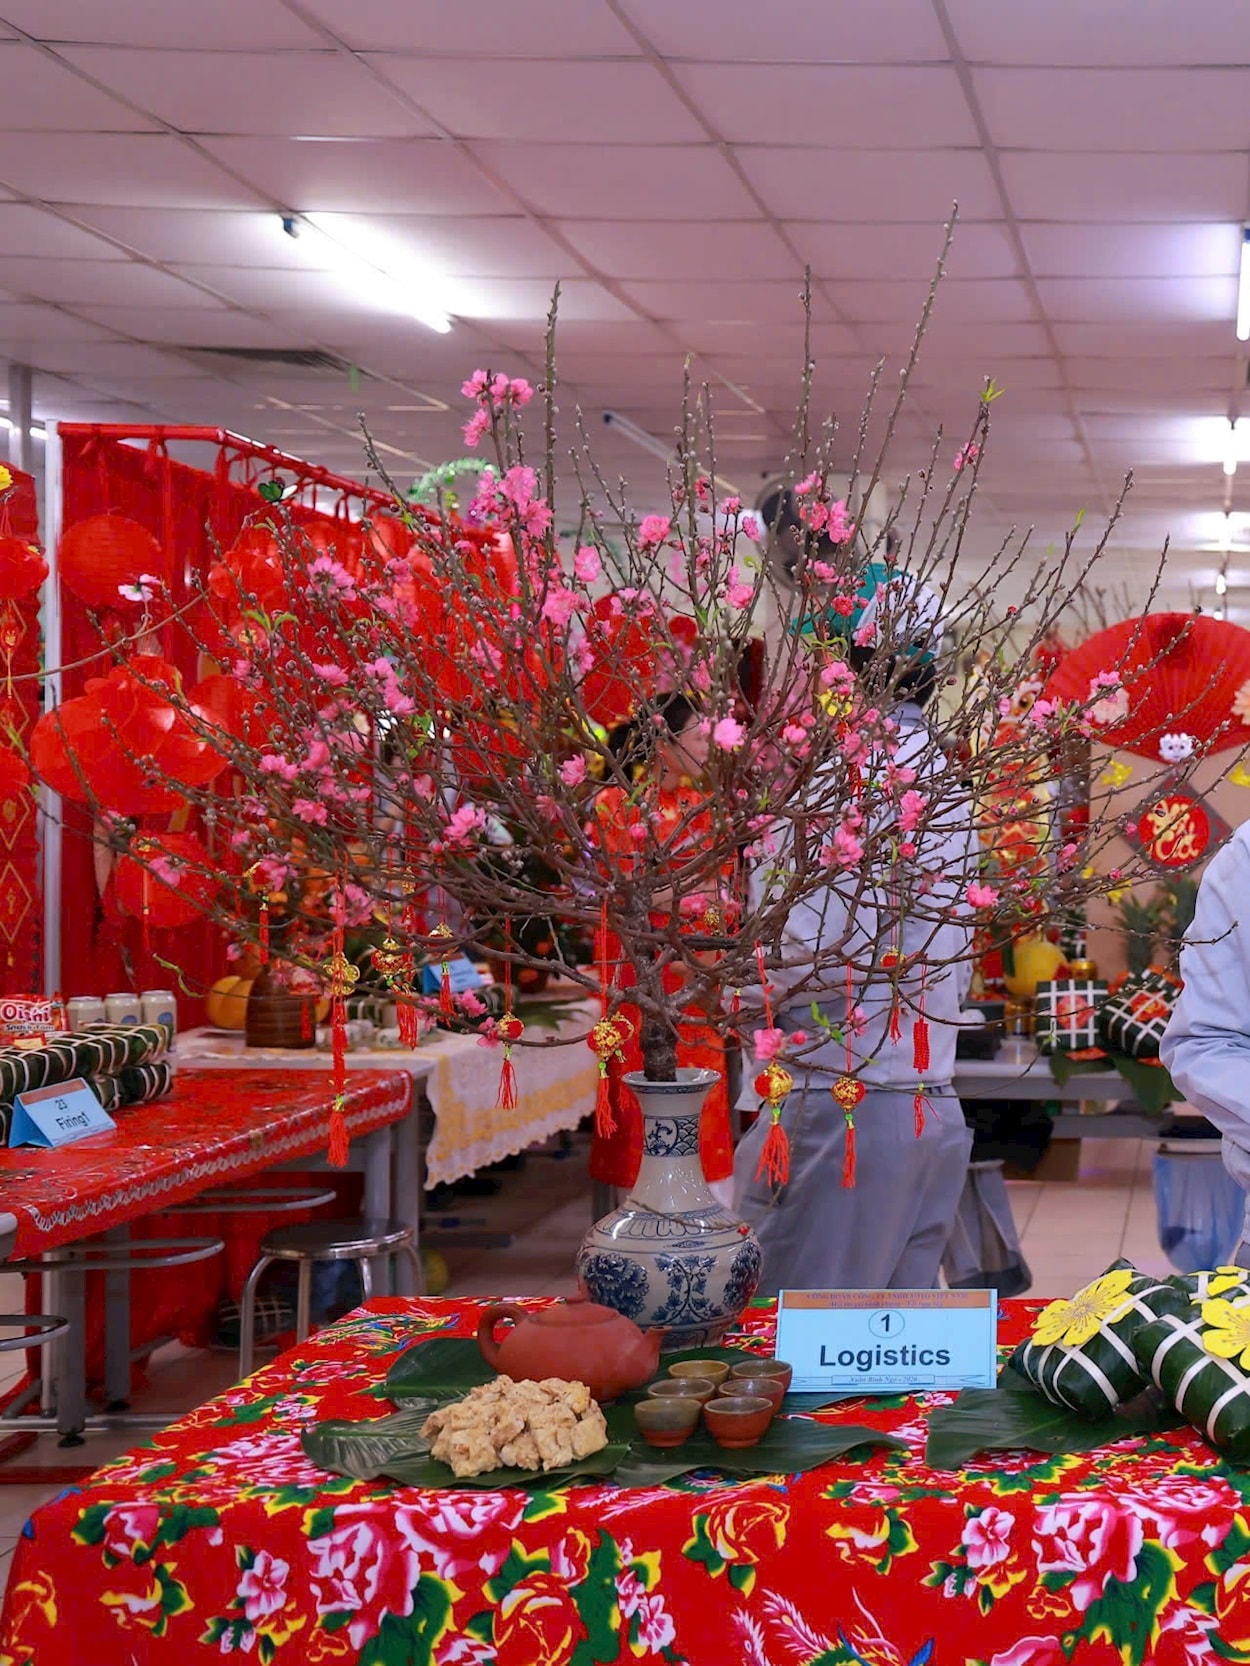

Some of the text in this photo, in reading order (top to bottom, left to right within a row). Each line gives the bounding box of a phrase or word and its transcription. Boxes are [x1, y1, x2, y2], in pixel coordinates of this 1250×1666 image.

[1, 1003, 52, 1022] Oishi
[55, 1099, 68, 1111] 23
[56, 1111, 91, 1130] Firing1
[881, 1313, 891, 1332] 1
[820, 1345, 950, 1372] Logistics
